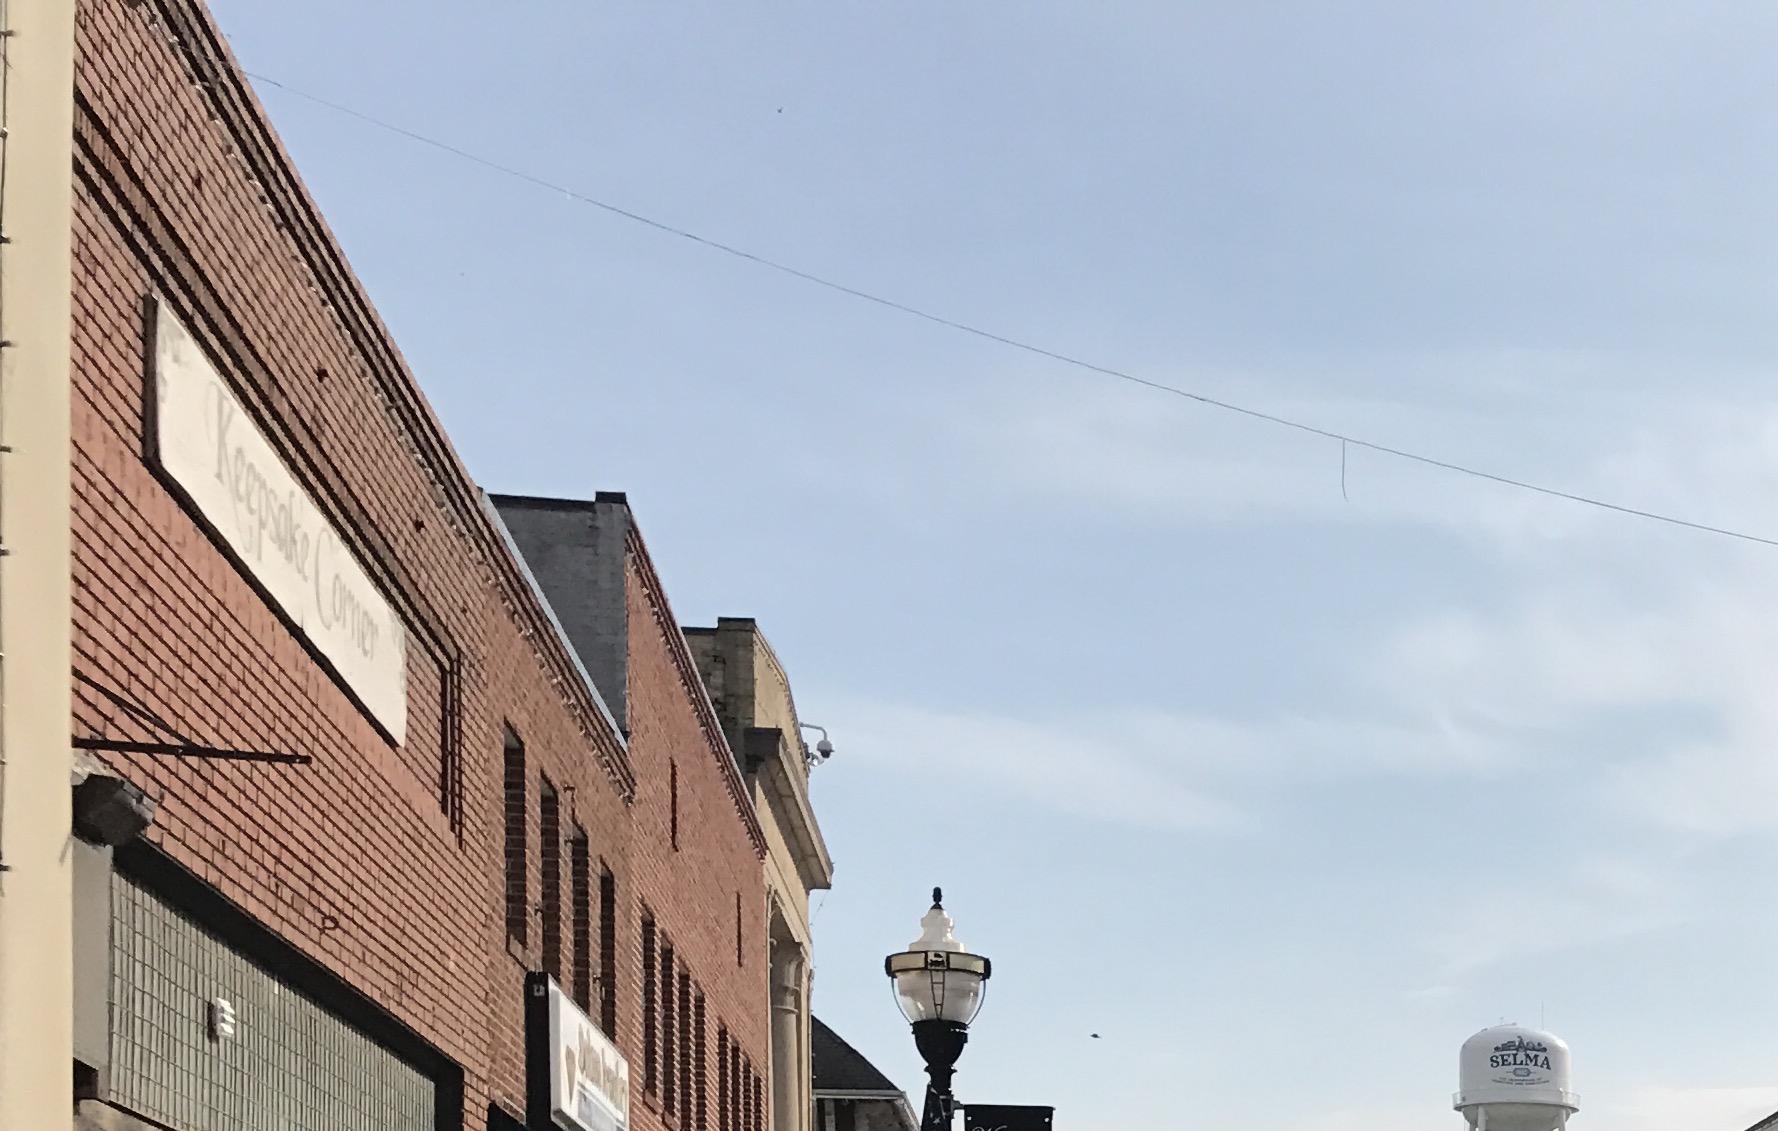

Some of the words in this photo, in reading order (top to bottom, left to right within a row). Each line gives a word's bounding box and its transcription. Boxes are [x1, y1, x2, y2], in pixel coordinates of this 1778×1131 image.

[205, 381, 308, 582] Keepsake
[314, 526, 379, 660] Corner
[1489, 1053, 1552, 1071] SELMA
